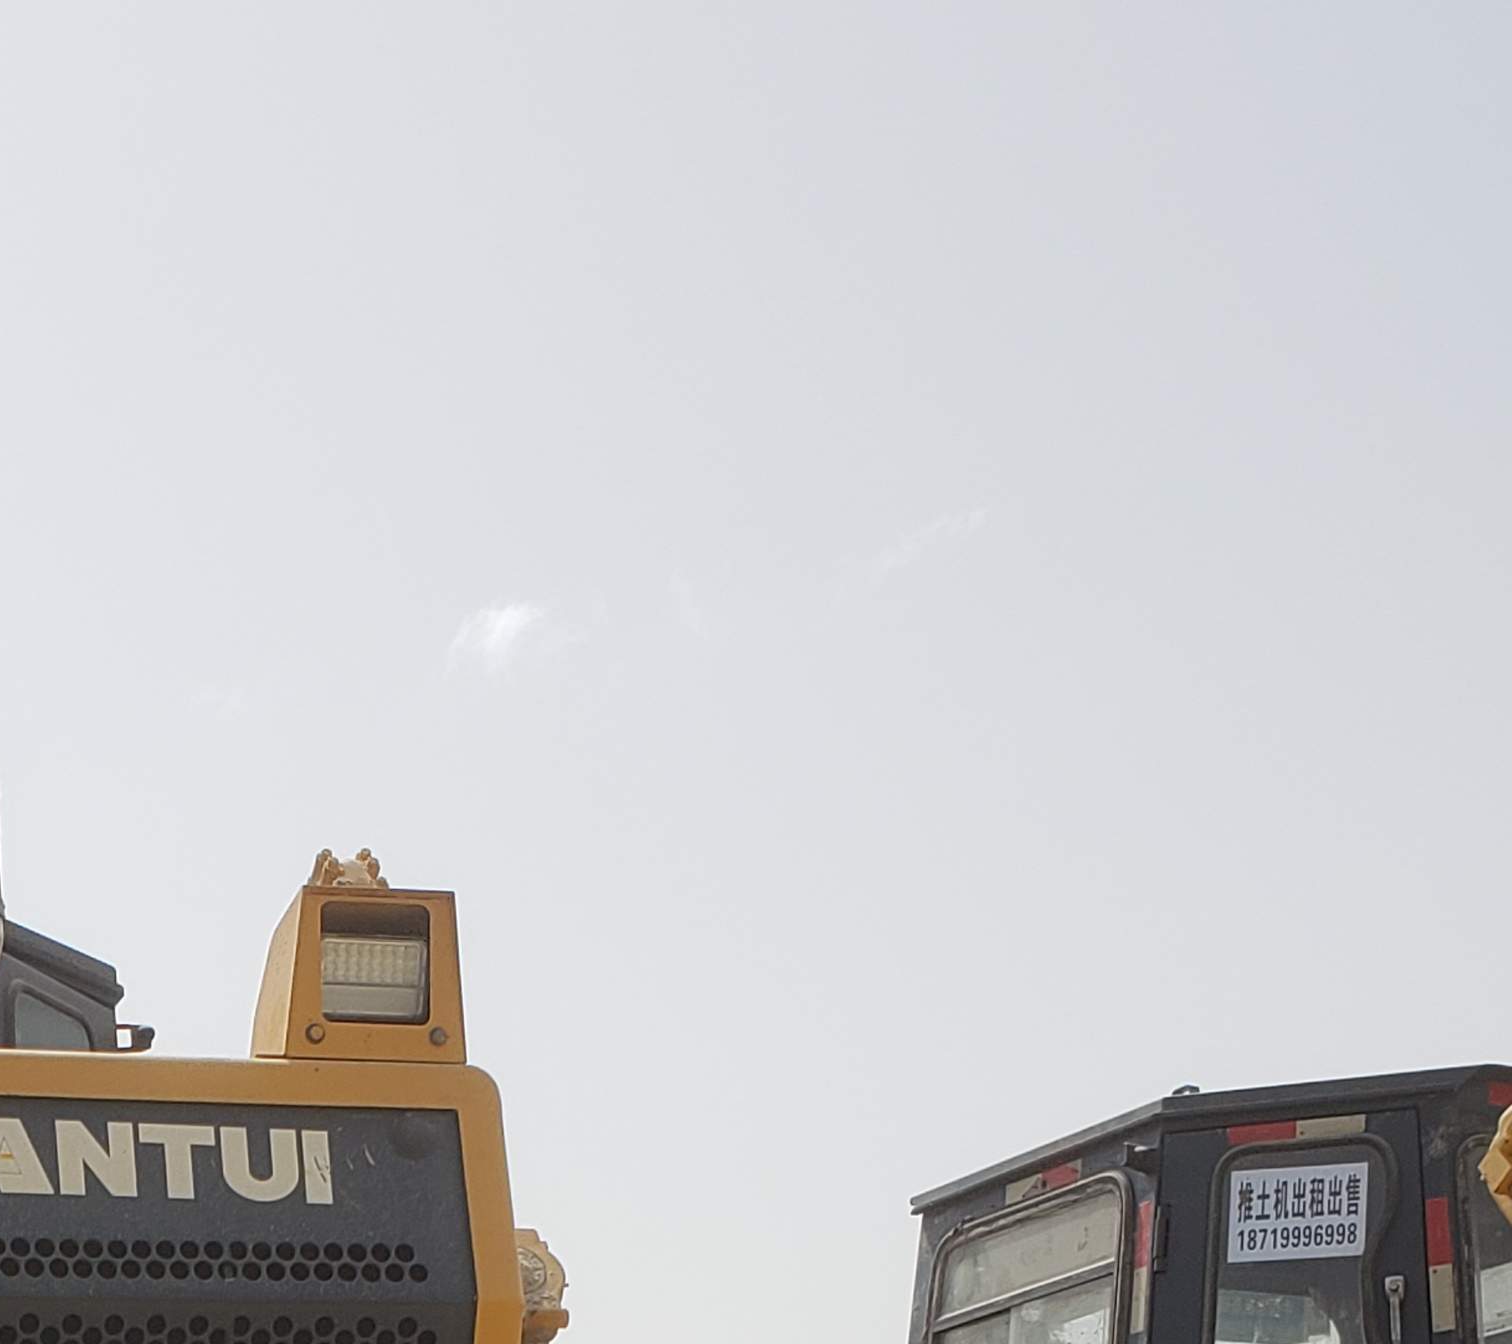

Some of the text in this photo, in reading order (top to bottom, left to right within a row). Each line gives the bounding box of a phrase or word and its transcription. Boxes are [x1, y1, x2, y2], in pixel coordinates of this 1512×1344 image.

[1237, 1173, 1361, 1223] 推土机出租出售
[1237, 1222, 1358, 1252] 18719996998
